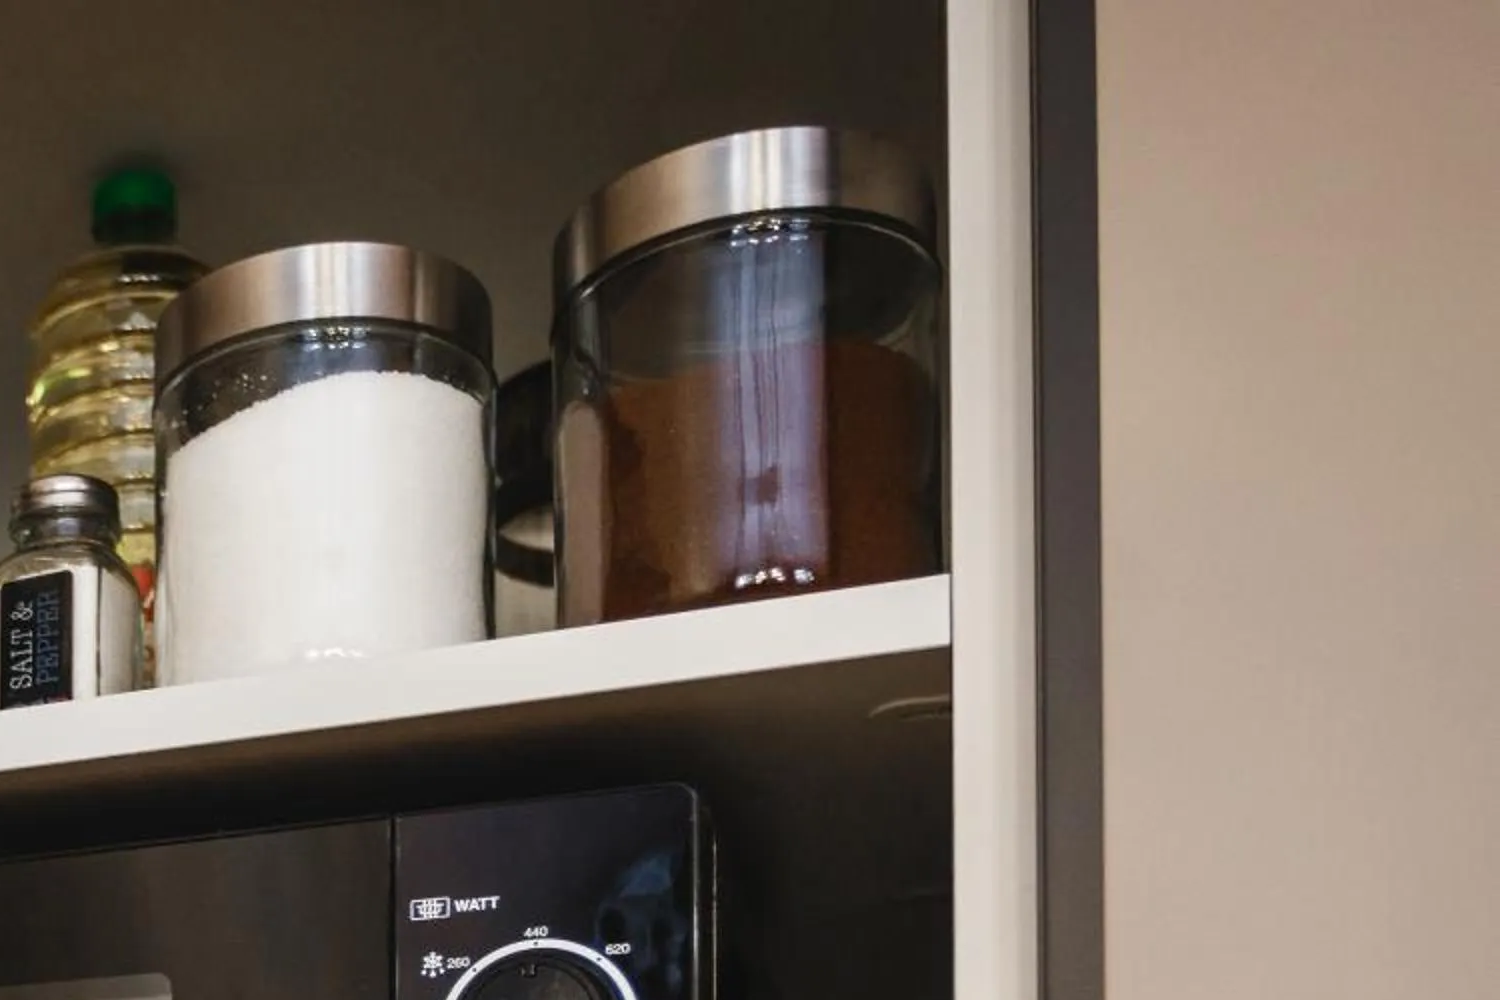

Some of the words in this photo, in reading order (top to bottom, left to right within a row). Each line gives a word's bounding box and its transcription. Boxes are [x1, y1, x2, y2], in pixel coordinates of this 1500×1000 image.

[10, 601, 33, 621] &
[36, 591, 60, 685] PEPPER
[9, 629, 33, 689] SALT
[453, 895, 500, 913] WATT
[523, 925, 549, 937] 440
[605, 942, 631, 955] 620
[446, 956, 471, 969] 260
